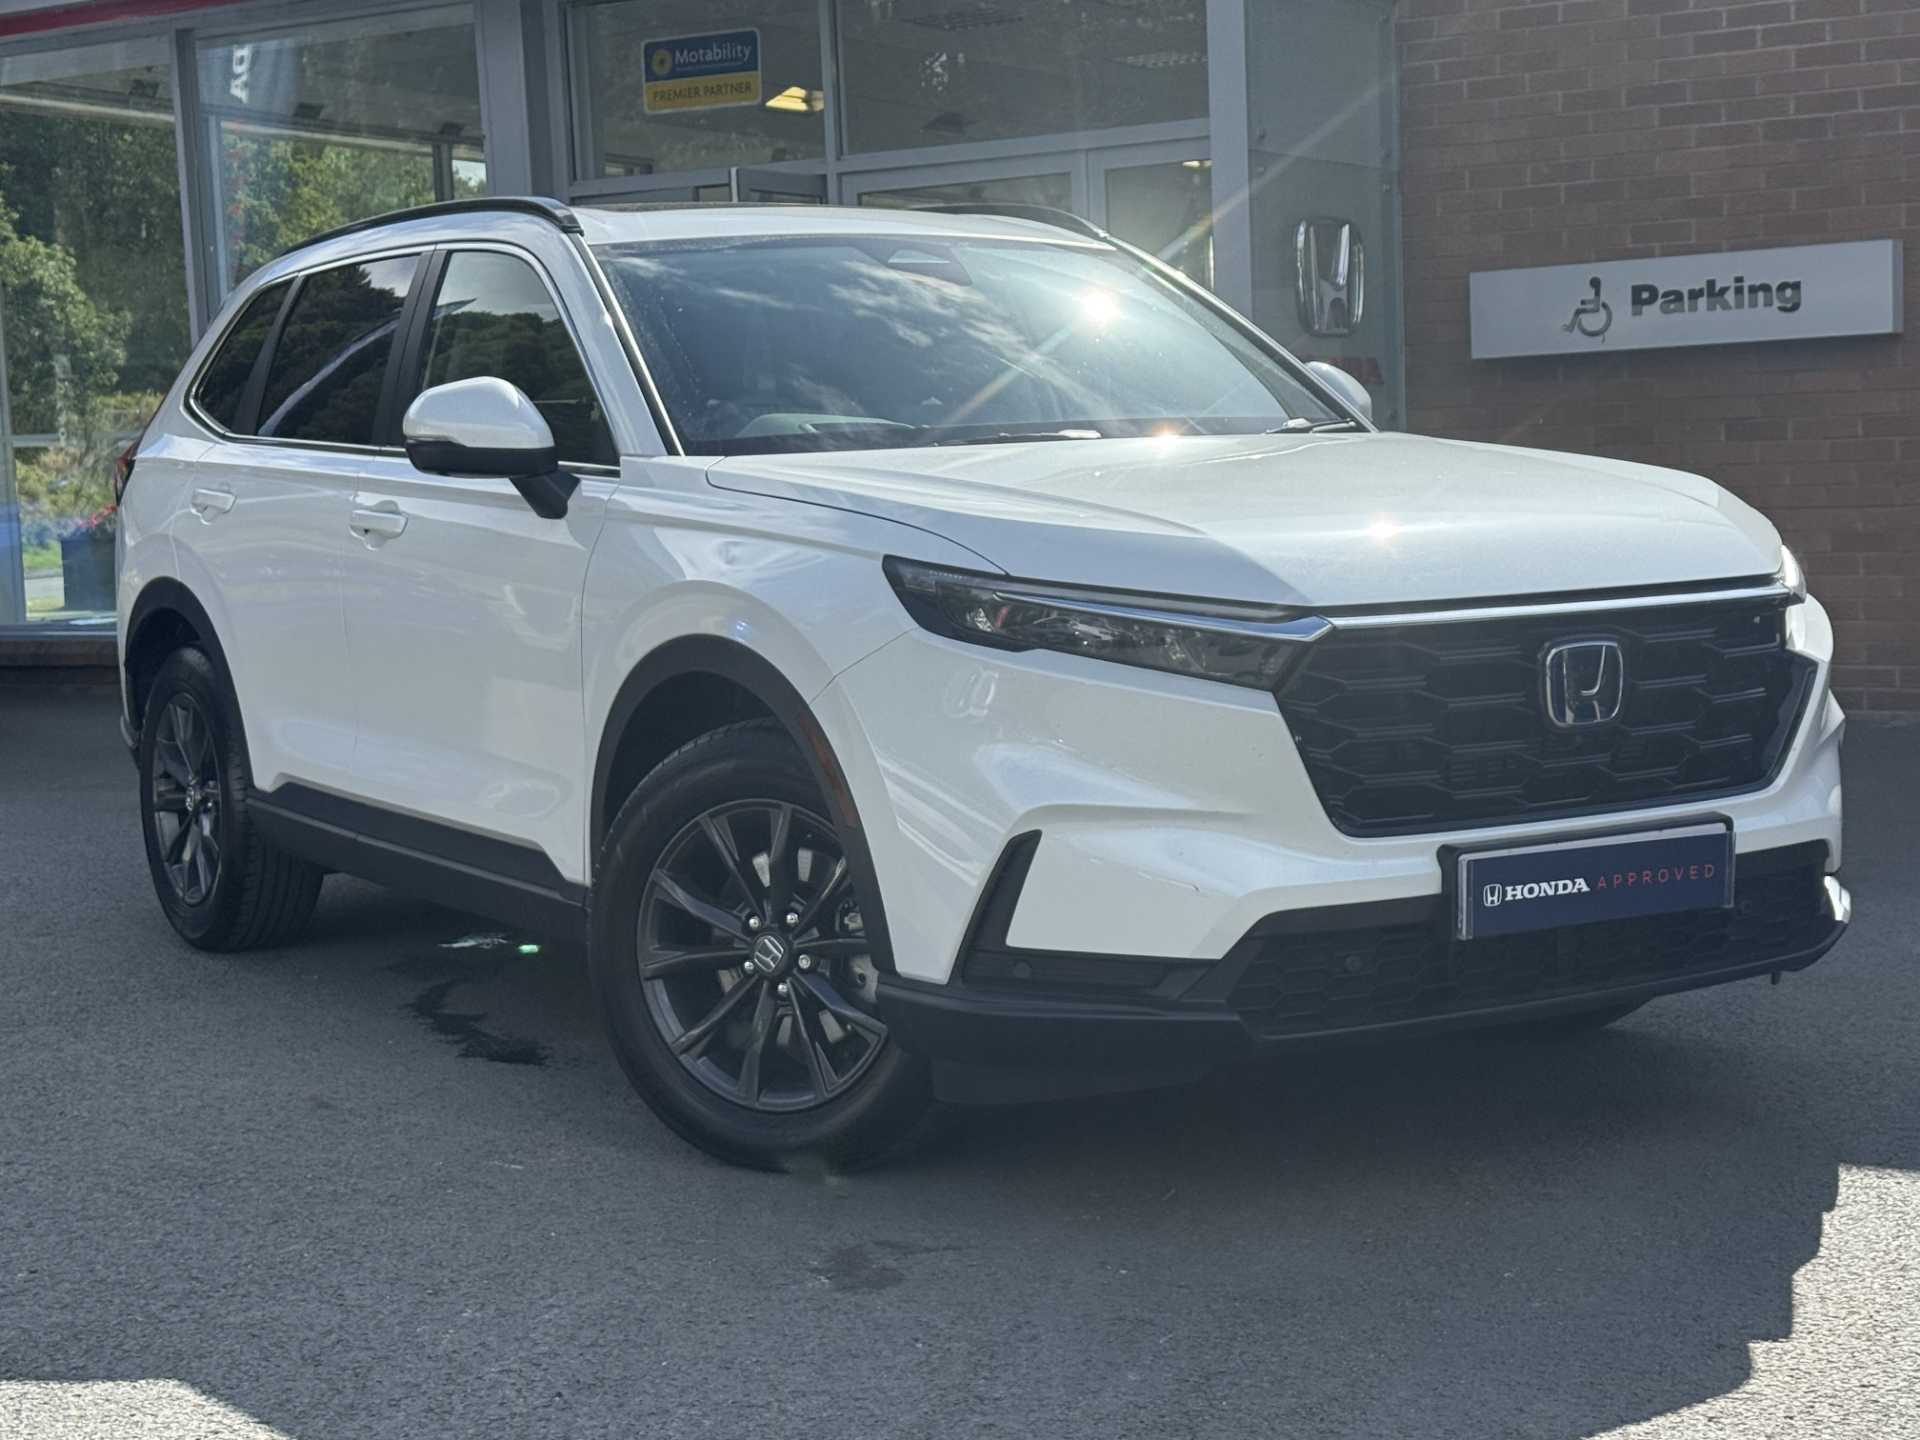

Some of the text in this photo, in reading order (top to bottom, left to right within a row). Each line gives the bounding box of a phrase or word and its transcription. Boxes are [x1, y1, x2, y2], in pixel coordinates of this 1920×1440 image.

[674, 41, 752, 65] Motability
[653, 80, 752, 102] PREMIER PARTNER
[1630, 275, 1803, 317] Parking
[1504, 863, 1715, 902] HONDA APPROVED
